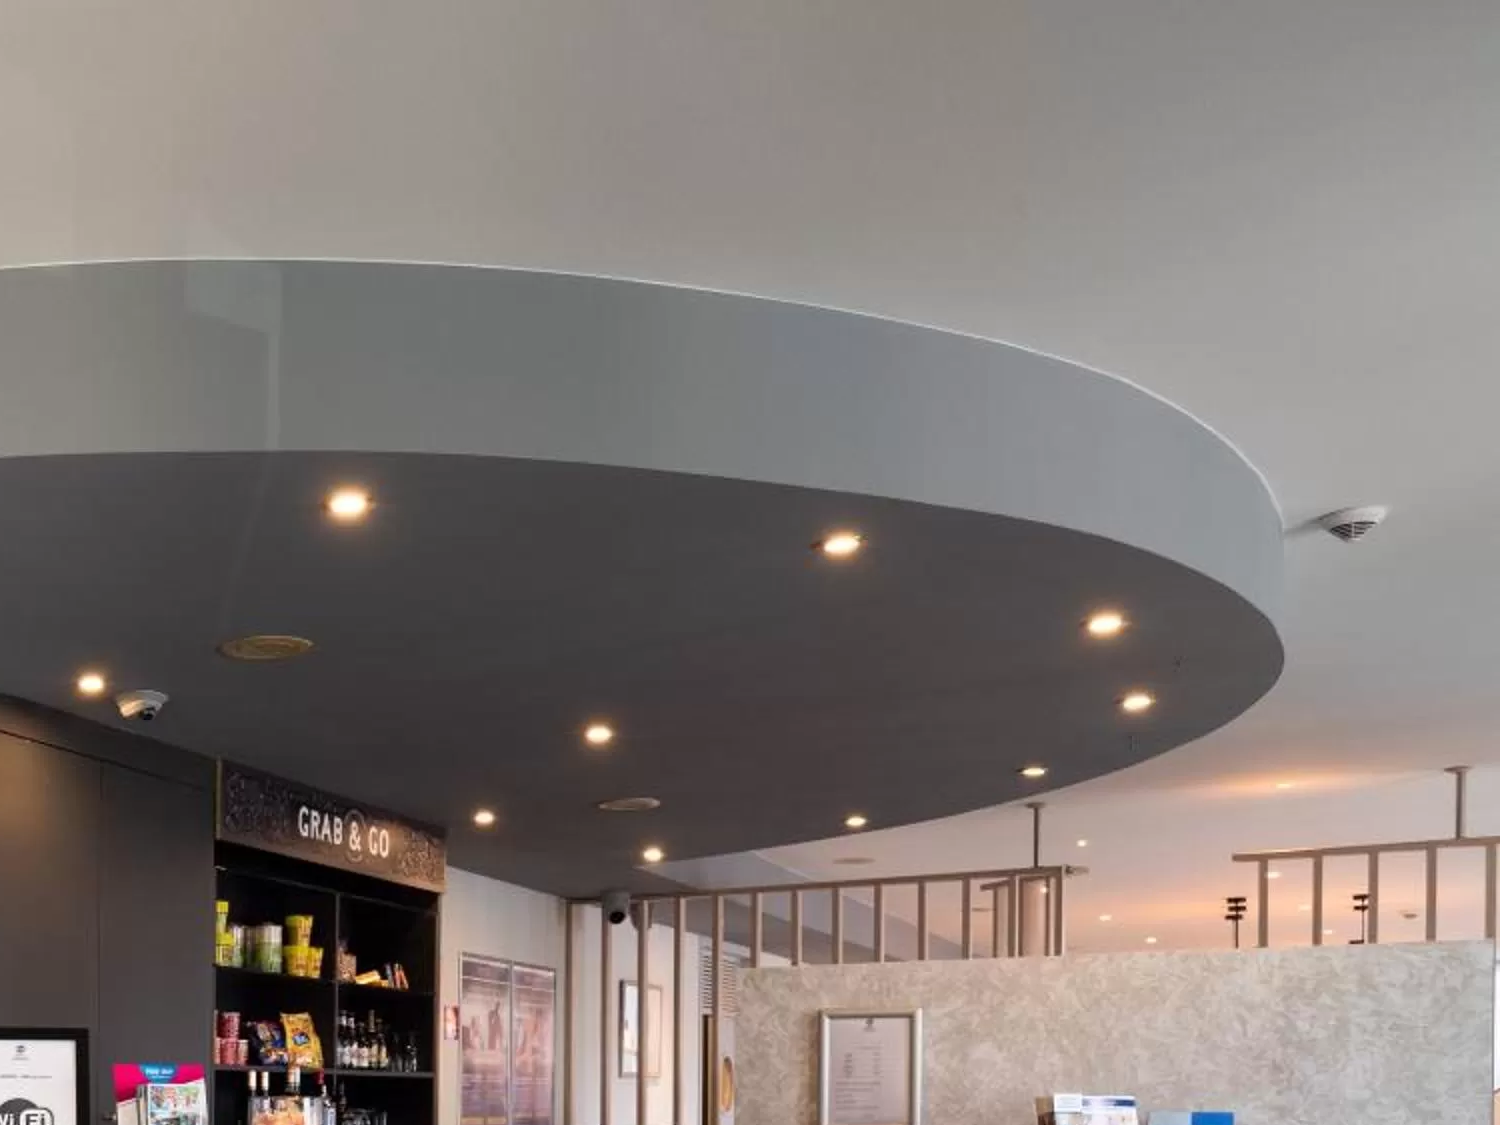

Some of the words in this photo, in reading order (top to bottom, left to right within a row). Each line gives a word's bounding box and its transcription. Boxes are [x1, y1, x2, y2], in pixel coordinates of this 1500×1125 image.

[298, 805, 343, 845] GRAB
[349, 821, 362, 853] &
[368, 826, 390, 858] GO
